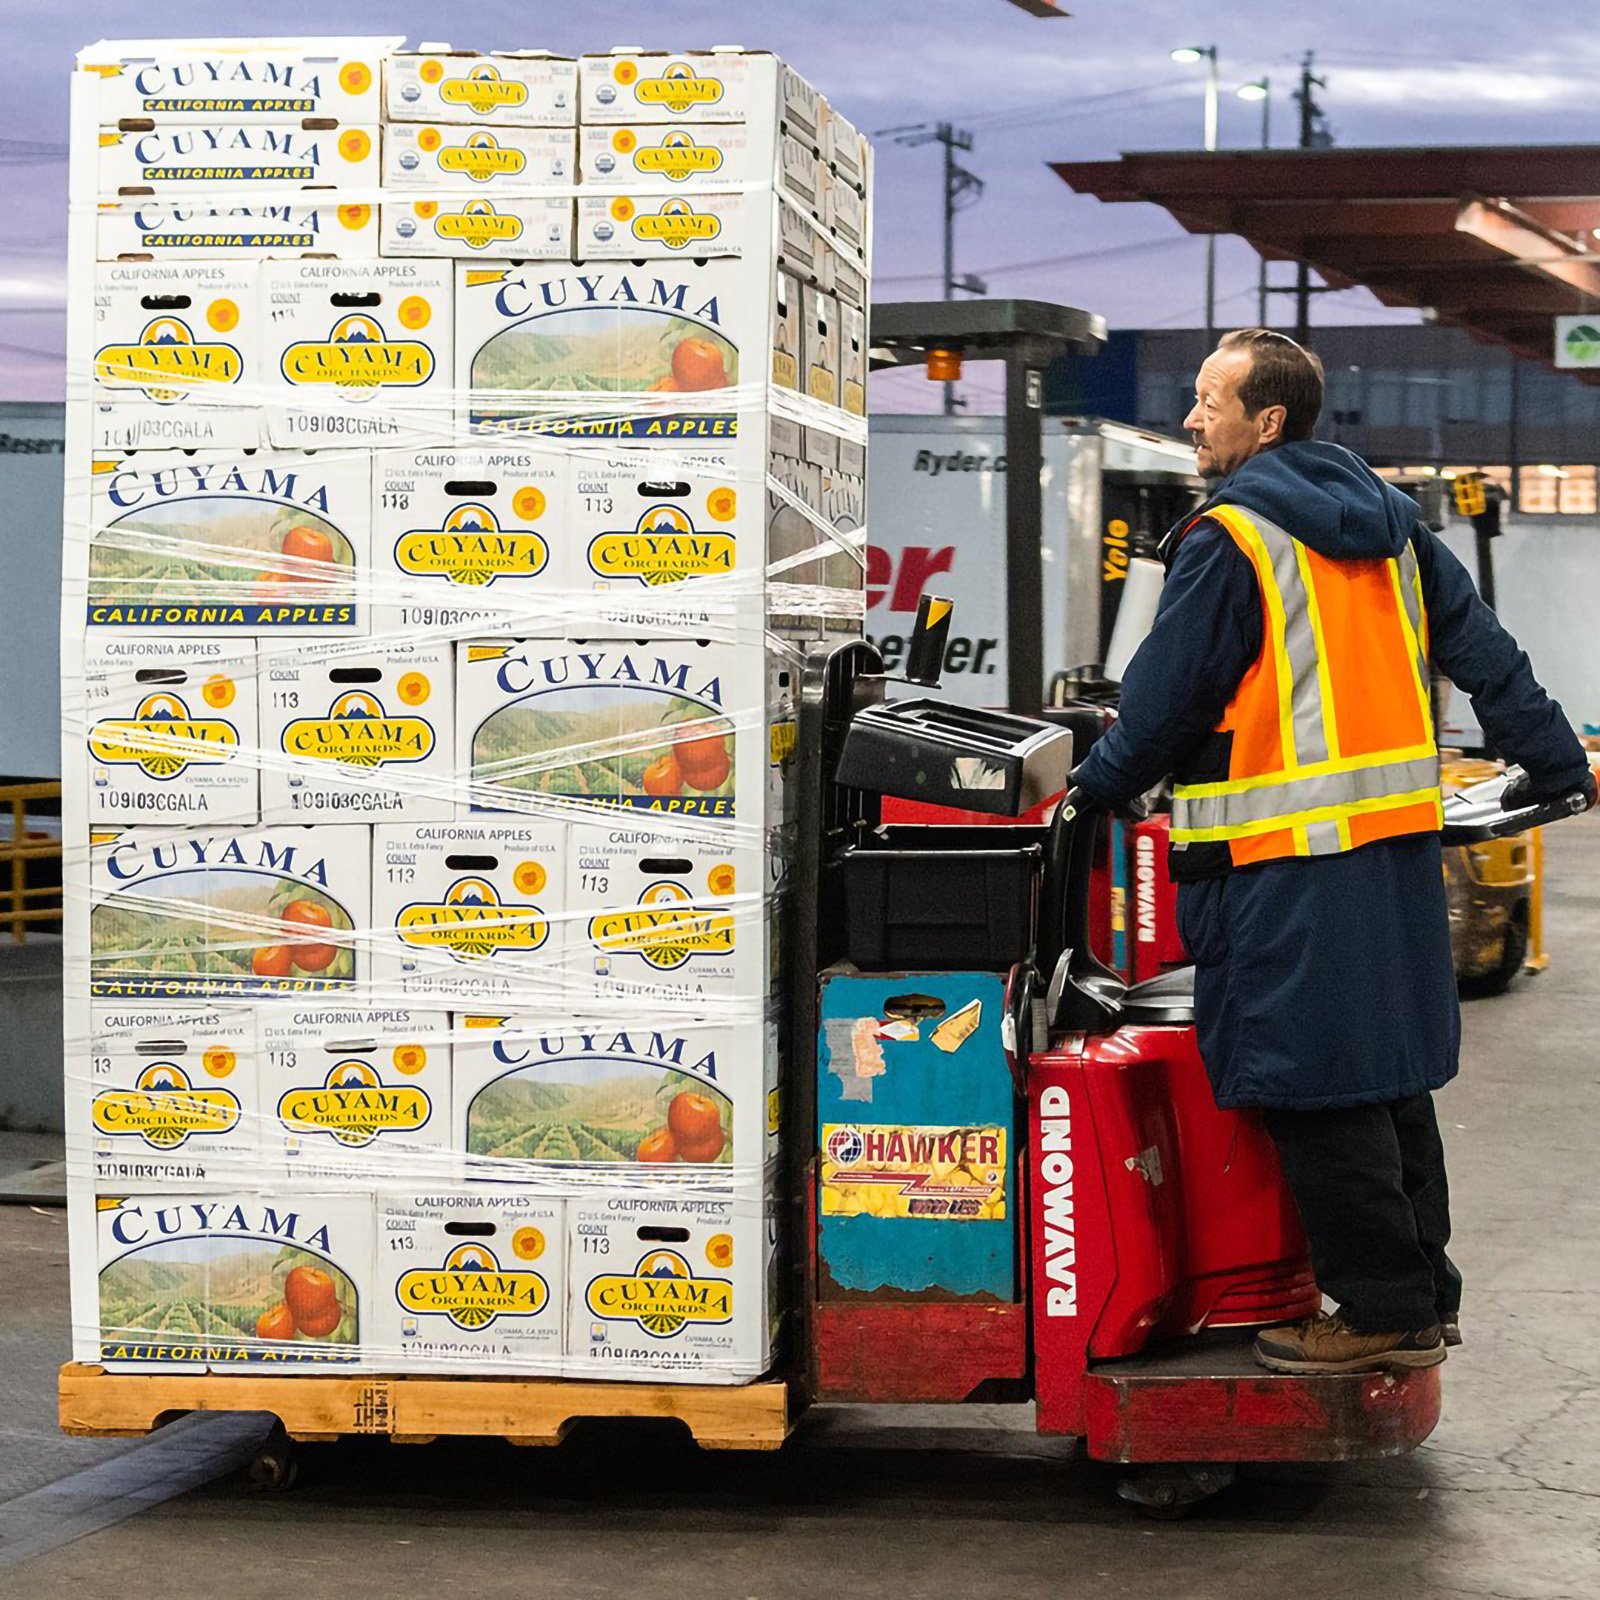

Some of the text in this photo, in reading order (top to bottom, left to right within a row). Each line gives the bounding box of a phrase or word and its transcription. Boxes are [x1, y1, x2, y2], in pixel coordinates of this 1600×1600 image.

[134, 60, 322, 99] CUYAMA
[144, 100, 313, 111] CALIFORNIA APPLES
[134, 126, 320, 166] CUYAMA
[144, 168, 312, 179] CALIFORNIA APPLES
[143, 235, 312, 246] CALIFORNIA APPLES
[111, 268, 225, 280] CALIFORNIA APPLES
[300, 266, 416, 278] CALIFORNIA APPLES
[271, 293, 301, 303] COUNT
[495, 275, 721, 326] CUYAMA
[295, 348, 422, 375] CUYAMA
[647, 420, 738, 436] APPLES
[487, 456, 531, 467] APPLES
[913, 450, 1007, 475] Ryder.c
[108, 464, 330, 514] CUYAMA
[385, 481, 415, 491] COUNT
[578, 483, 608, 493] COUNT
[585, 498, 613, 514] 113
[408, 536, 536, 566] CUYAMA
[601, 538, 731, 567] CUYAMA
[92, 607, 352, 623] CALIFORNIA APPLES
[106, 644, 221, 655] CALIFORNIA APPLES
[270, 670, 299, 681] COUNT
[496, 653, 723, 707] CUYAMA
[273, 692, 299, 708] 113
[295, 723, 422, 751] CUYAMA
[317, 744, 401, 753] ORCHARDS
[648, 799, 735, 816] APPLES
[416, 828, 532, 841] CALIFORNIA APPLES
[106, 837, 329, 888] CUYAMA
[386, 854, 417, 865] COUNT
[579, 858, 609, 869] COUNT
[582, 874, 608, 893] 113
[1136, 835, 1155, 942] RAYMOND
[431, 931, 515, 940] ORCHARDS
[105, 1016, 172, 1027] CALIFORNIA
[294, 1011, 410, 1025] CALIFORNIA APPLES
[270, 1052, 297, 1068] 113
[493, 1026, 718, 1081] CUYAMA
[292, 1092, 419, 1120] CUYAMA
[125, 1117, 208, 1125] ORCHARDS
[314, 1115, 398, 1123] ORCHARDS
[866, 1133, 999, 1164] HAWKER
[415, 1197, 531, 1208] CALIFORNIA APPLES
[608, 1200, 726, 1214] CALIFORNIA APPLES
[1040, 1086, 1078, 1317] RAYMOND
[112, 1203, 332, 1254] CUYAMA
[386, 1220, 416, 1231] COUNT
[577, 1224, 608, 1235] COUNT
[391, 1236, 414, 1251] 113
[583, 1237, 610, 1255] 113
[409, 1275, 536, 1305] CUYAMA
[600, 1281, 728, 1314] CUYAMA
[622, 1302, 707, 1313] ORCHARDS
[99, 1345, 248, 1361] CALIFORNIA
